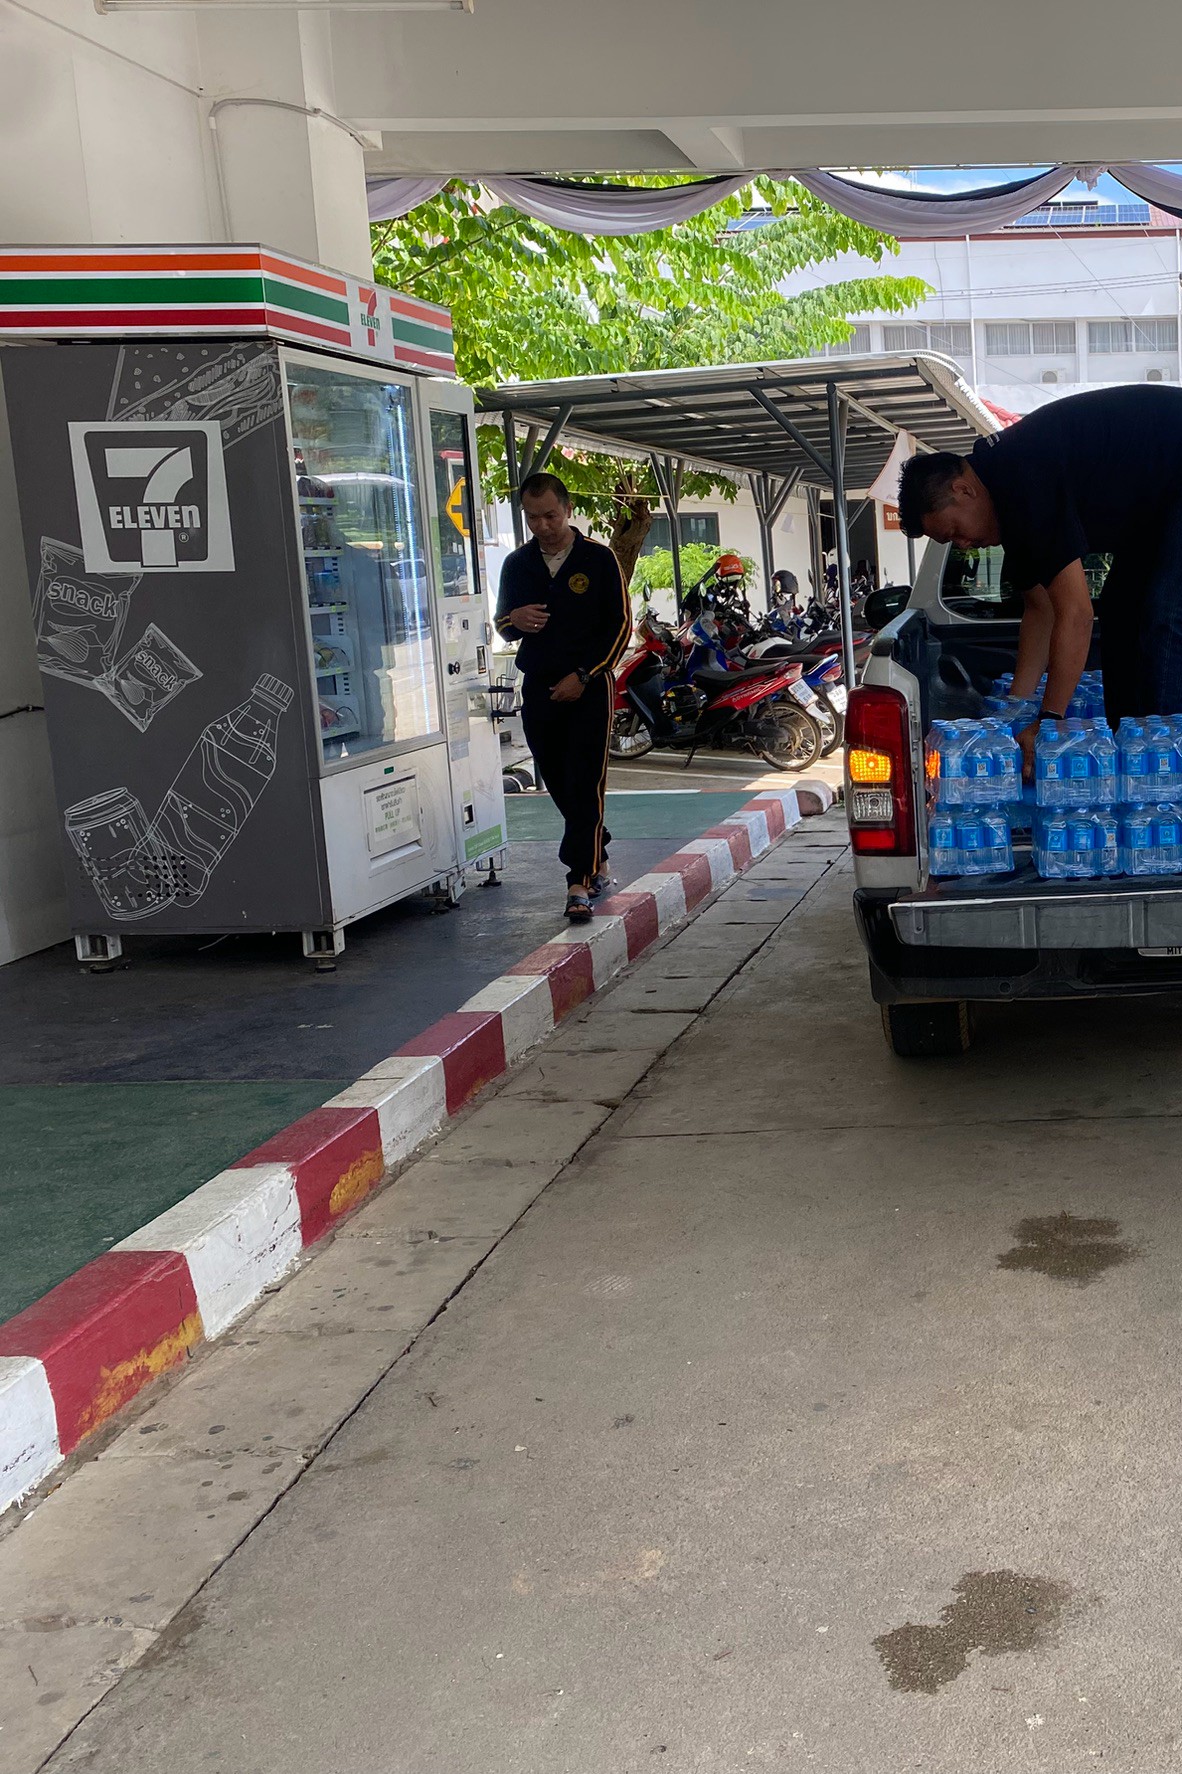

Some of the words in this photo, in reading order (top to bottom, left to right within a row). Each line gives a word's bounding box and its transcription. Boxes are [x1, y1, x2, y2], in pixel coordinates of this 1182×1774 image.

[357, 287, 377, 346] 7
[105, 446, 193, 566] 7
[47, 581, 119, 618] snack
[135, 650, 178, 692] snack
